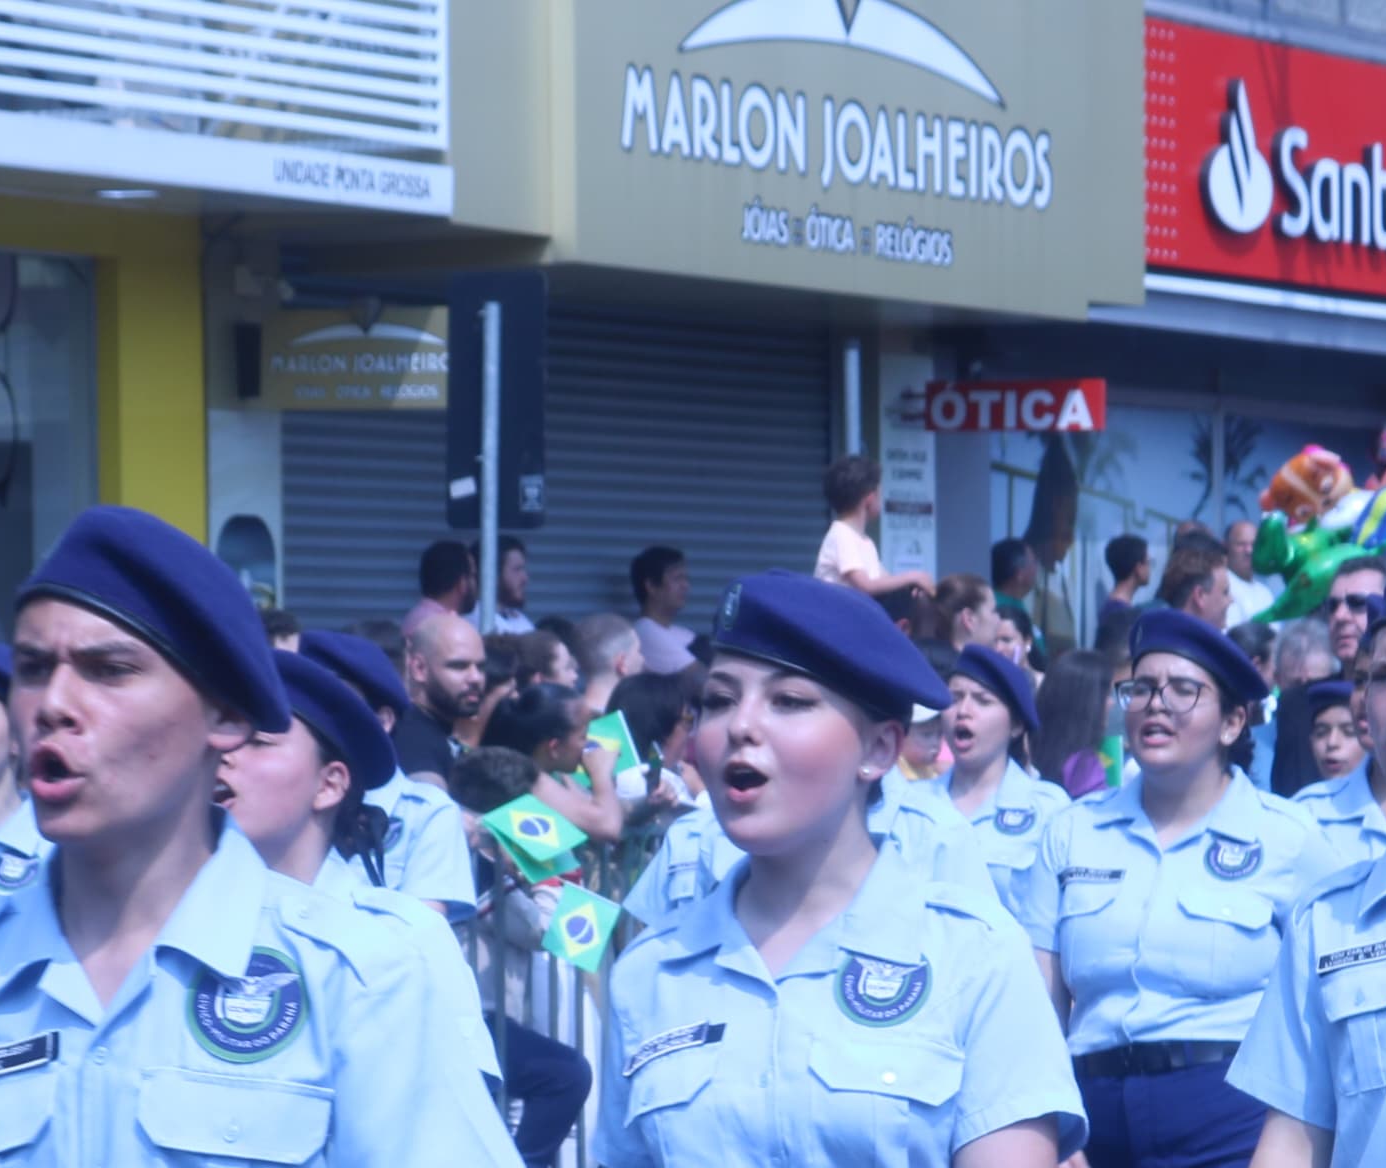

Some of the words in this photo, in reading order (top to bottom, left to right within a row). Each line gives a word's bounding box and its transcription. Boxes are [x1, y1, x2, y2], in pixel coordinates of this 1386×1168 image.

[621, 62, 808, 176] MARLON
[820, 97, 1053, 211] JOALHEIROS
[273, 159, 330, 187] UNIDADE
[335, 166, 375, 192] PONTA
[380, 171, 431, 198] GROSSA
[743, 196, 789, 244] JÓIAS
[805, 205, 855, 252] ÓTICA
[875, 218, 952, 265] RELÓGIOS
[271, 354, 347, 374] MARLON
[930, 383, 1094, 430] ÓTICA
